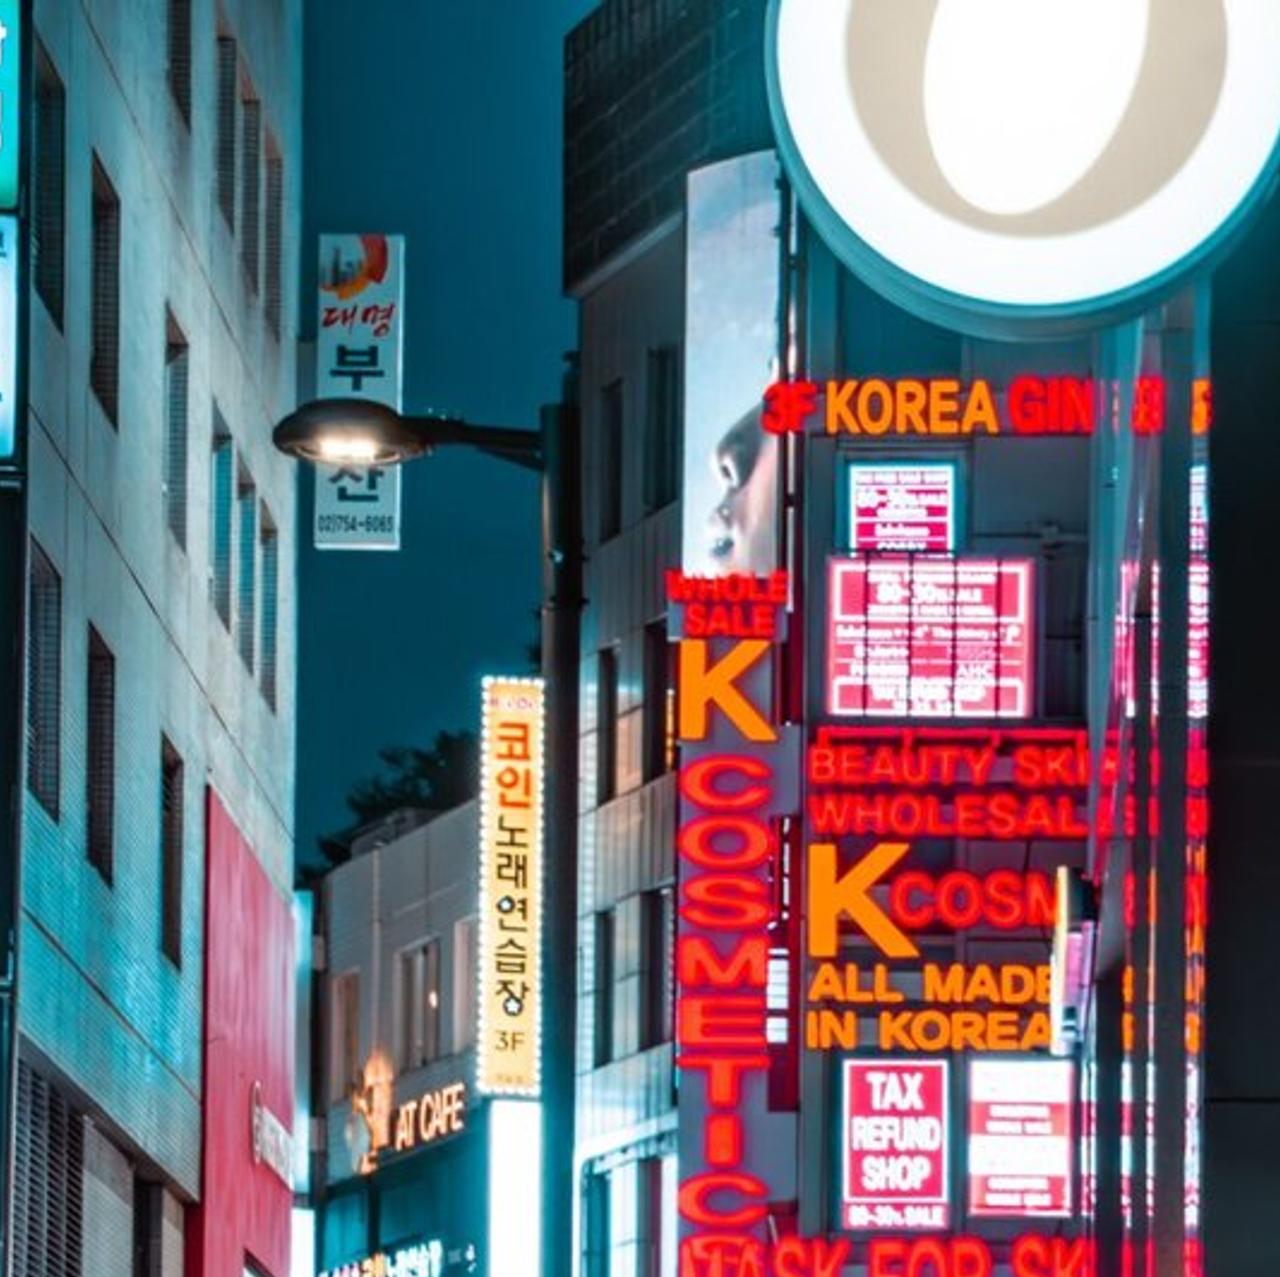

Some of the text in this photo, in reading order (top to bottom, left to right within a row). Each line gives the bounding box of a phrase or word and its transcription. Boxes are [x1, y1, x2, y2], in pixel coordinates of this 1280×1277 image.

[321, 302, 397, 338] 대명
[329, 345, 384, 503] 부산
[826, 379, 998, 434] KOREA
[684, 602, 775, 637] SALE
[809, 747, 991, 786] BEAUTY
[809, 964, 1053, 1003] ALL MADE
[494, 1029, 525, 1052] 3F
[808, 1012, 1053, 1050] IN KOREA
[866, 1071, 924, 1110] TAX
[396, 1082, 465, 1152] AT CAFE
[852, 1117, 941, 1151] REFUND
[862, 1156, 931, 1191] SHOP
